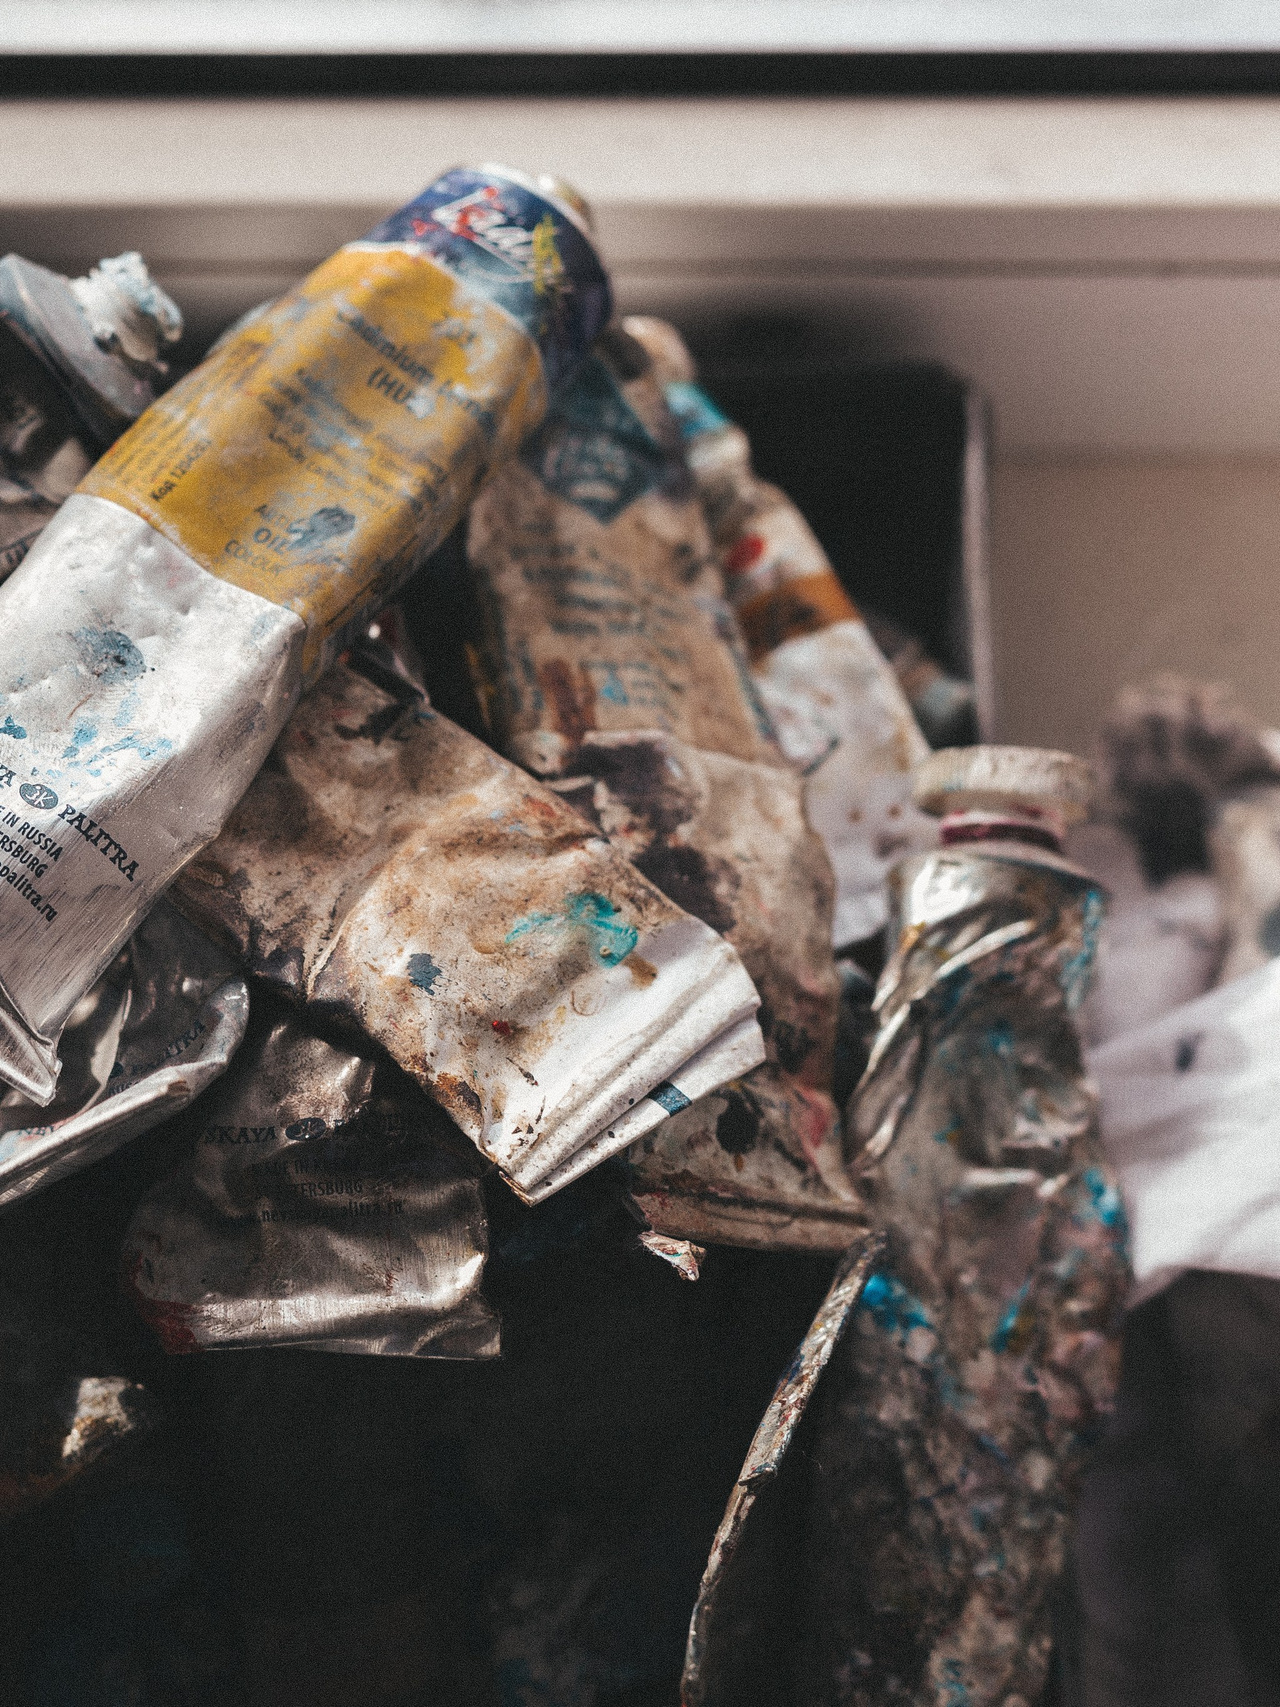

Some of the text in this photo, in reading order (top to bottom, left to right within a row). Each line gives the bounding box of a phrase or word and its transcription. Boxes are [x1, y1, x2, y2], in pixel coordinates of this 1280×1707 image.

[4, 811, 18, 827] IN
[18, 822, 63, 862] RUSSIA
[59, 804, 139, 882] PALITRA
[203, 1119, 276, 1147] SKAYA
